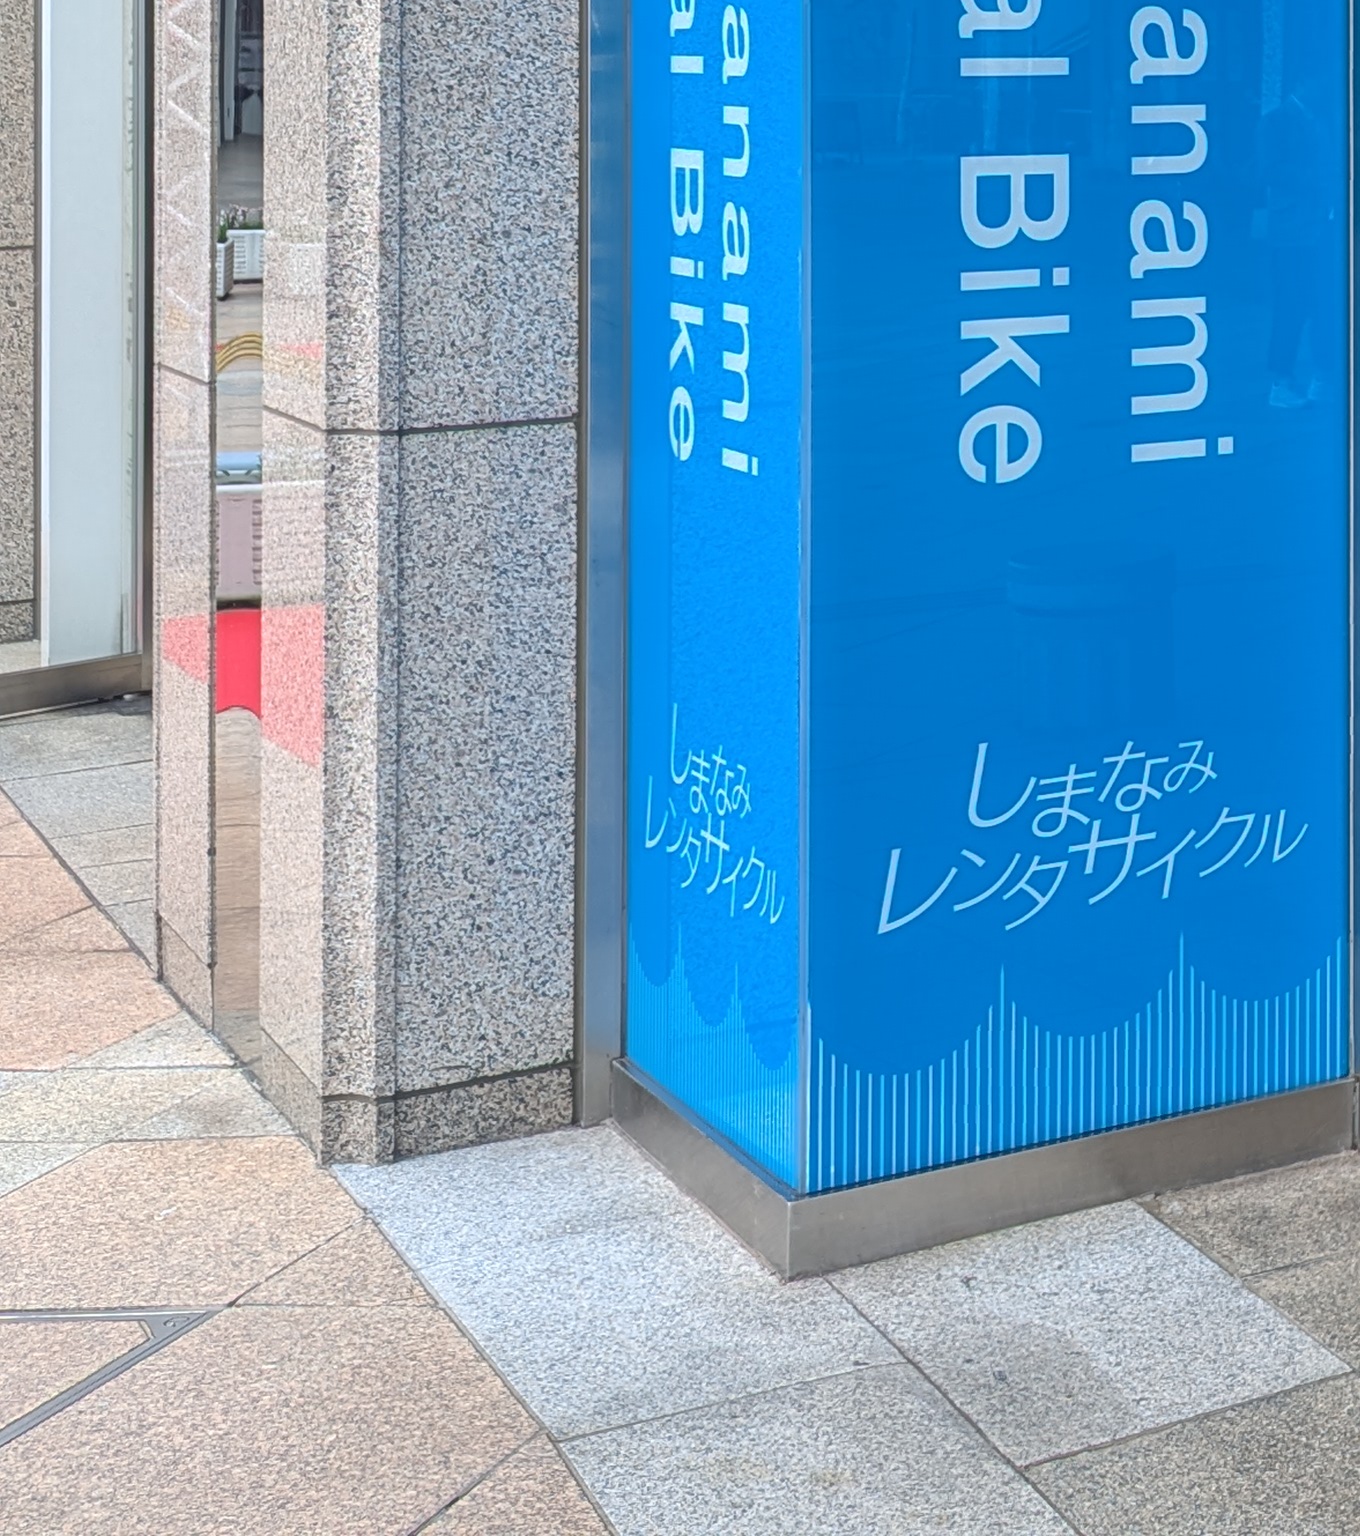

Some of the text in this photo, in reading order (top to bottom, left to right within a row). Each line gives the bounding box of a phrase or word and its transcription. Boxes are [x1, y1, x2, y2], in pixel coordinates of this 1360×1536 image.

[668, 148, 705, 462] Bike
[957, 153, 1070, 485] Bike
[669, 702, 753, 819] しまなみ
[966, 739, 1219, 839] しまなみ
[644, 775, 786, 926] レンタサイクル
[876, 805, 1309, 935] レンタサイクル
